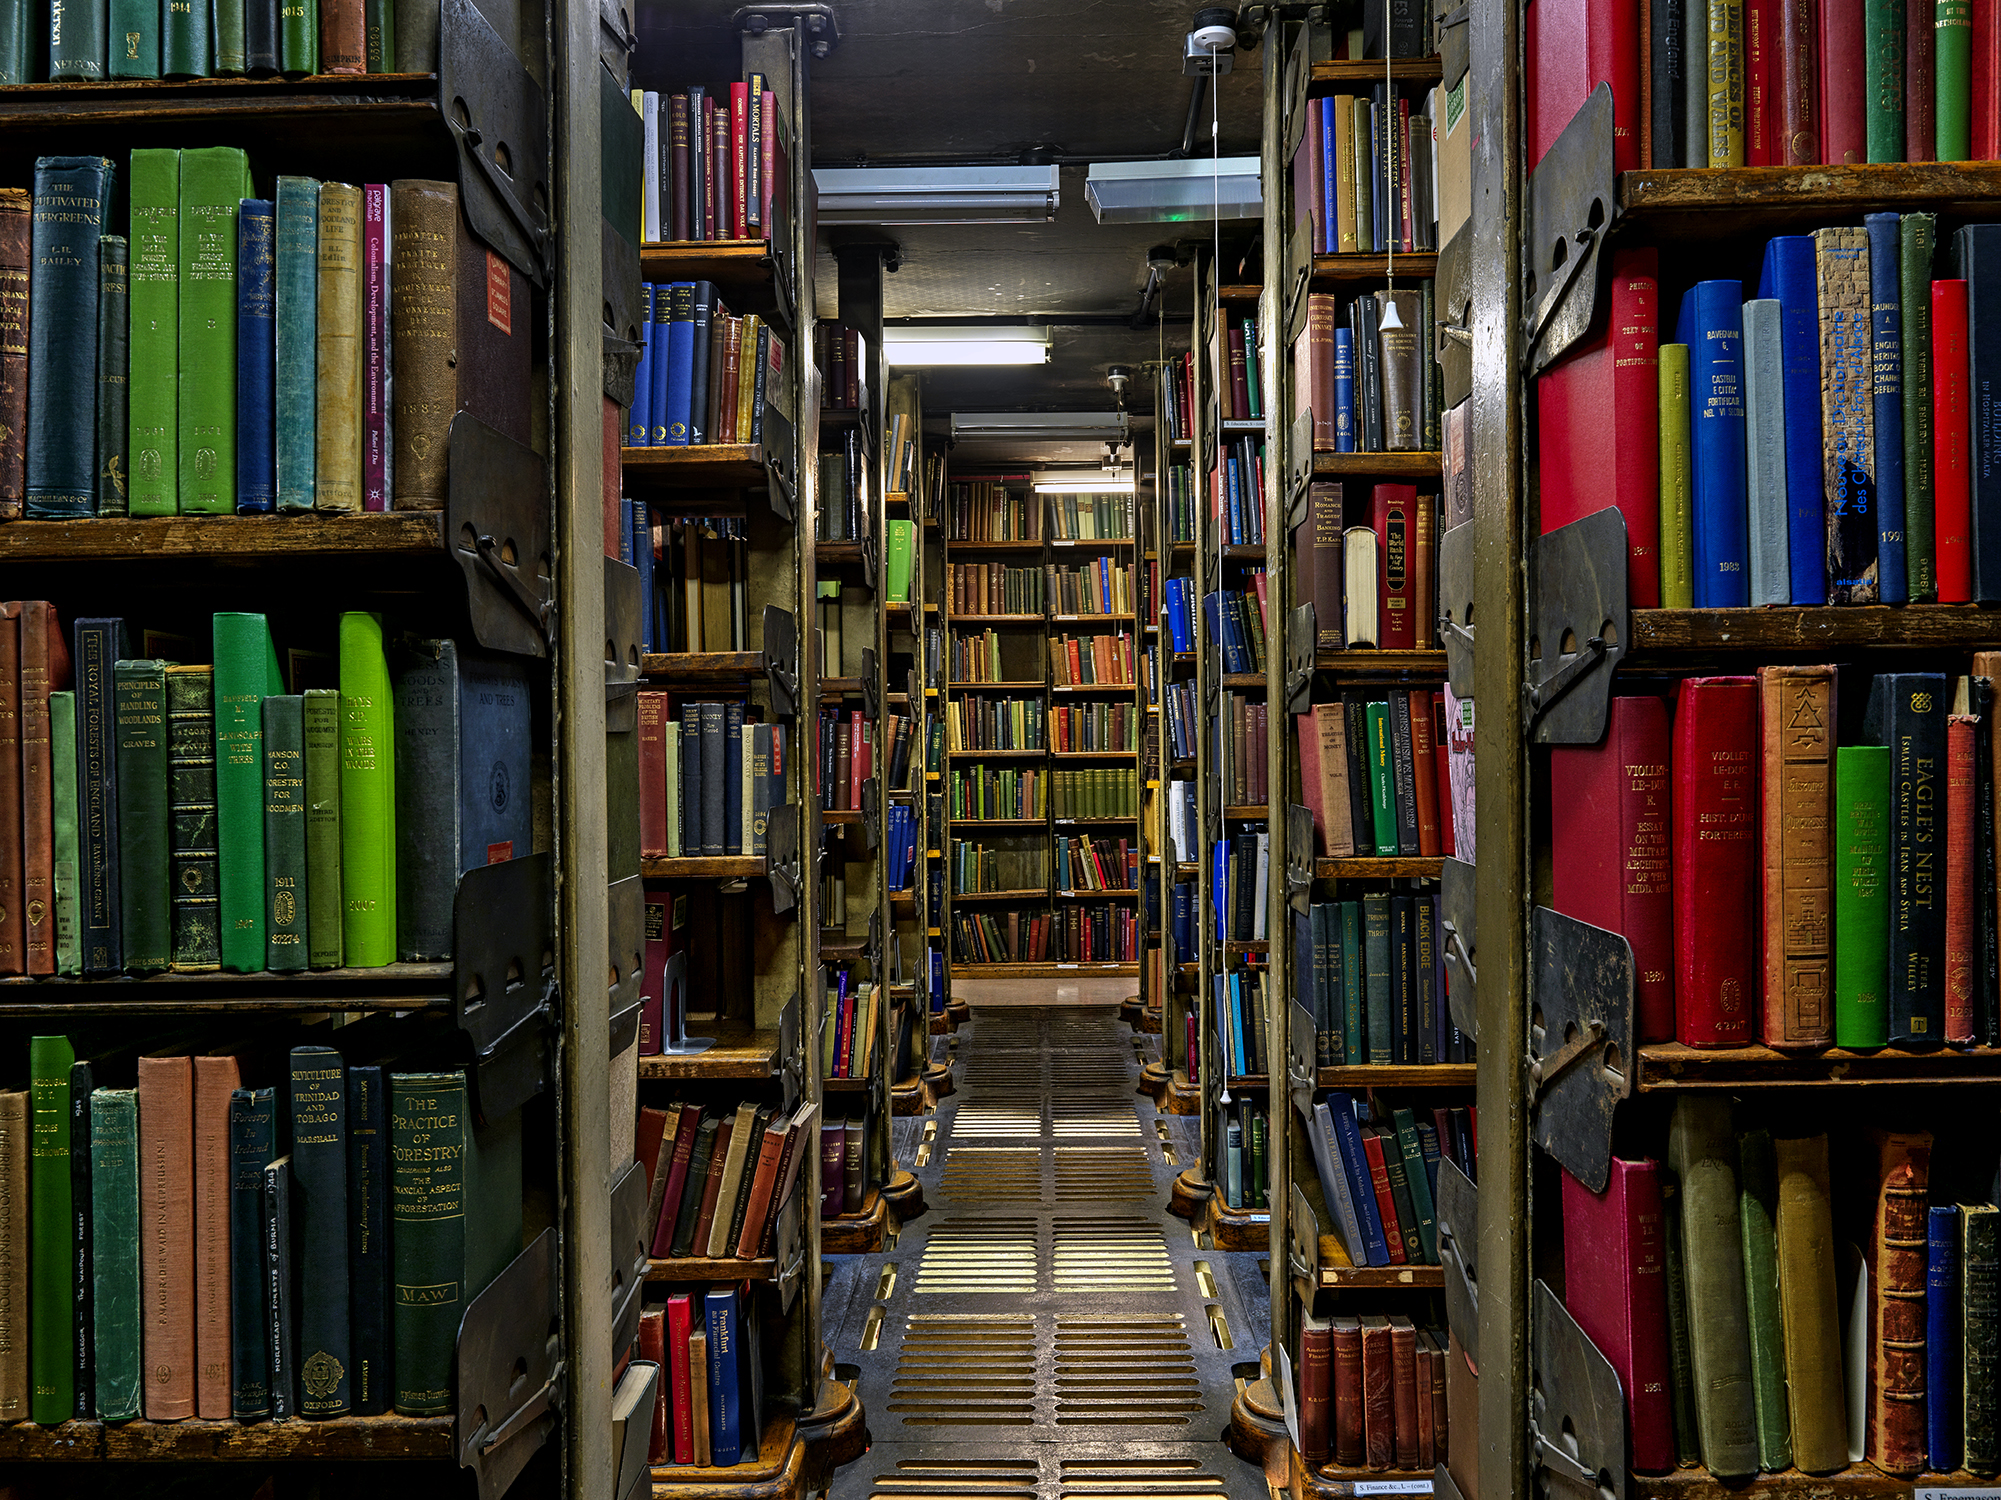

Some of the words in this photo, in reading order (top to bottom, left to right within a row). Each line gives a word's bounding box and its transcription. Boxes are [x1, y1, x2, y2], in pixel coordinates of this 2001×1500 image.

[281, 6, 304, 18] 2015
[324, 55, 361, 64] SIMPKIN
[1727, 4, 1742, 102] DEFENCES
[54, 60, 100, 71] NELSON
[1710, 39, 1729, 84] AND
[1880, 27, 1902, 112] FORTS
[1711, 89, 1730, 158] WALES
[1729, 105, 1742, 134] OF
[52, 184, 73, 192] THE
[34, 196, 100, 208] CULTIVATED
[373, 189, 381, 222] palgrave
[326, 225, 344, 233] LIFE
[1916, 227, 1924, 250] 1911
[40, 257, 82, 266] BAILEY
[322, 254, 346, 262] Edlin
[370, 237, 379, 284] Colonialism,
[369, 285, 379, 336] Development,
[1849, 312, 1865, 375] d'Alsace
[1831, 311, 1846, 424] Dictionnaire
[1874, 364, 1895, 372] BOOK
[370, 366, 378, 415] Environment
[1852, 378, 1865, 412] Forts
[402, 404, 440, 415] 1882
[1851, 417, 1868, 485] Châteaux
[1834, 434, 1849, 517] Nouveau
[1852, 489, 1867, 514] des
[1391, 532, 1402, 540] The
[87, 634, 98, 661] THE
[88, 664, 99, 705] ROYAL
[117, 681, 160, 690] PRINCIPLES
[120, 701, 158, 711] HANDLING
[346, 697, 372, 709] HAYS
[118, 715, 161, 725] WOODLANDS
[349, 711, 367, 722] S.P.
[89, 708, 100, 758] FORESTS
[1377, 717, 1386, 749] International
[1397, 697, 1410, 760] KEYNESIANISM
[123, 740, 156, 748] GRAVES
[229, 744, 253, 752] WITH
[347, 736, 373, 746] WARS
[356, 748, 375, 758] THE
[1901, 735, 1912, 777] ISMAILI
[90, 761, 100, 777] OF
[274, 762, 290, 771] C.O.
[345, 759, 375, 770] WOODS
[1714, 766, 1748, 775] LE-DUC
[274, 791, 290, 799] FOR
[1403, 775, 1415, 829] MONETARISM
[1915, 757, 1934, 843] EAGLE'S
[90, 780, 101, 838] ENGLAND
[1900, 782, 1912, 827] CASTLES
[1700, 814, 1727, 824] HIST.
[1637, 822, 1663, 832] ESSAY
[1635, 835, 1648, 844] ON
[1900, 831, 1908, 842] IN
[93, 842, 102, 887] RAYMOND
[1900, 846, 1910, 873] IRAN
[274, 877, 295, 888] 1911
[1636, 872, 1650, 882] OF
[1915, 851, 1933, 910] NEST
[1900, 877, 1908, 896] AND
[94, 889, 102, 920] GRANT
[350, 900, 376, 911] 2007
[1418, 905, 1430, 939] BLACK
[1899, 899, 1909, 932] SYRIA
[271, 934, 300, 944] 87274
[1368, 930, 1389, 938] THRIFT
[1420, 941, 1431, 969] EDGE
[1347, 954, 1355, 986] Reading
[1907, 952, 1919, 993] WILLEY
[1920, 955, 1930, 989] PETER
[1715, 1019, 1748, 1031] 42917
[292, 1069, 341, 1081] SILVICULTURE
[294, 1091, 340, 1102] TRINIDAD
[405, 1097, 437, 1110] THE
[296, 1112, 338, 1123] TOBAGO
[393, 1114, 458, 1129] PRACTICE
[297, 1134, 338, 1144] MARSHALL
[413, 1133, 431, 1144] OF
[1327, 1137, 1342, 1170] HEDGE
[267, 1170, 275, 1194] 1944
[413, 1177, 431, 1185] THE
[1335, 1172, 1348, 1199] FUND
[1339, 1201, 1358, 1240] MIRAGE
[270, 1253, 278, 1262] of
[271, 1269, 279, 1309] FORESTS
[402, 1288, 448, 1302] MAW
[712, 1310, 717, 1318] as
[719, 1309, 729, 1354] Frankfurt
[273, 1321, 281, 1373] MOREHEAD
[712, 1326, 720, 1360] Financial
[1645, 1383, 1662, 1393] 1951
[304, 1399, 342, 1409] OXFORD
[1366, 1482, 1388, 1490] Finance
[1411, 1482, 1429, 1490] (cont.)
